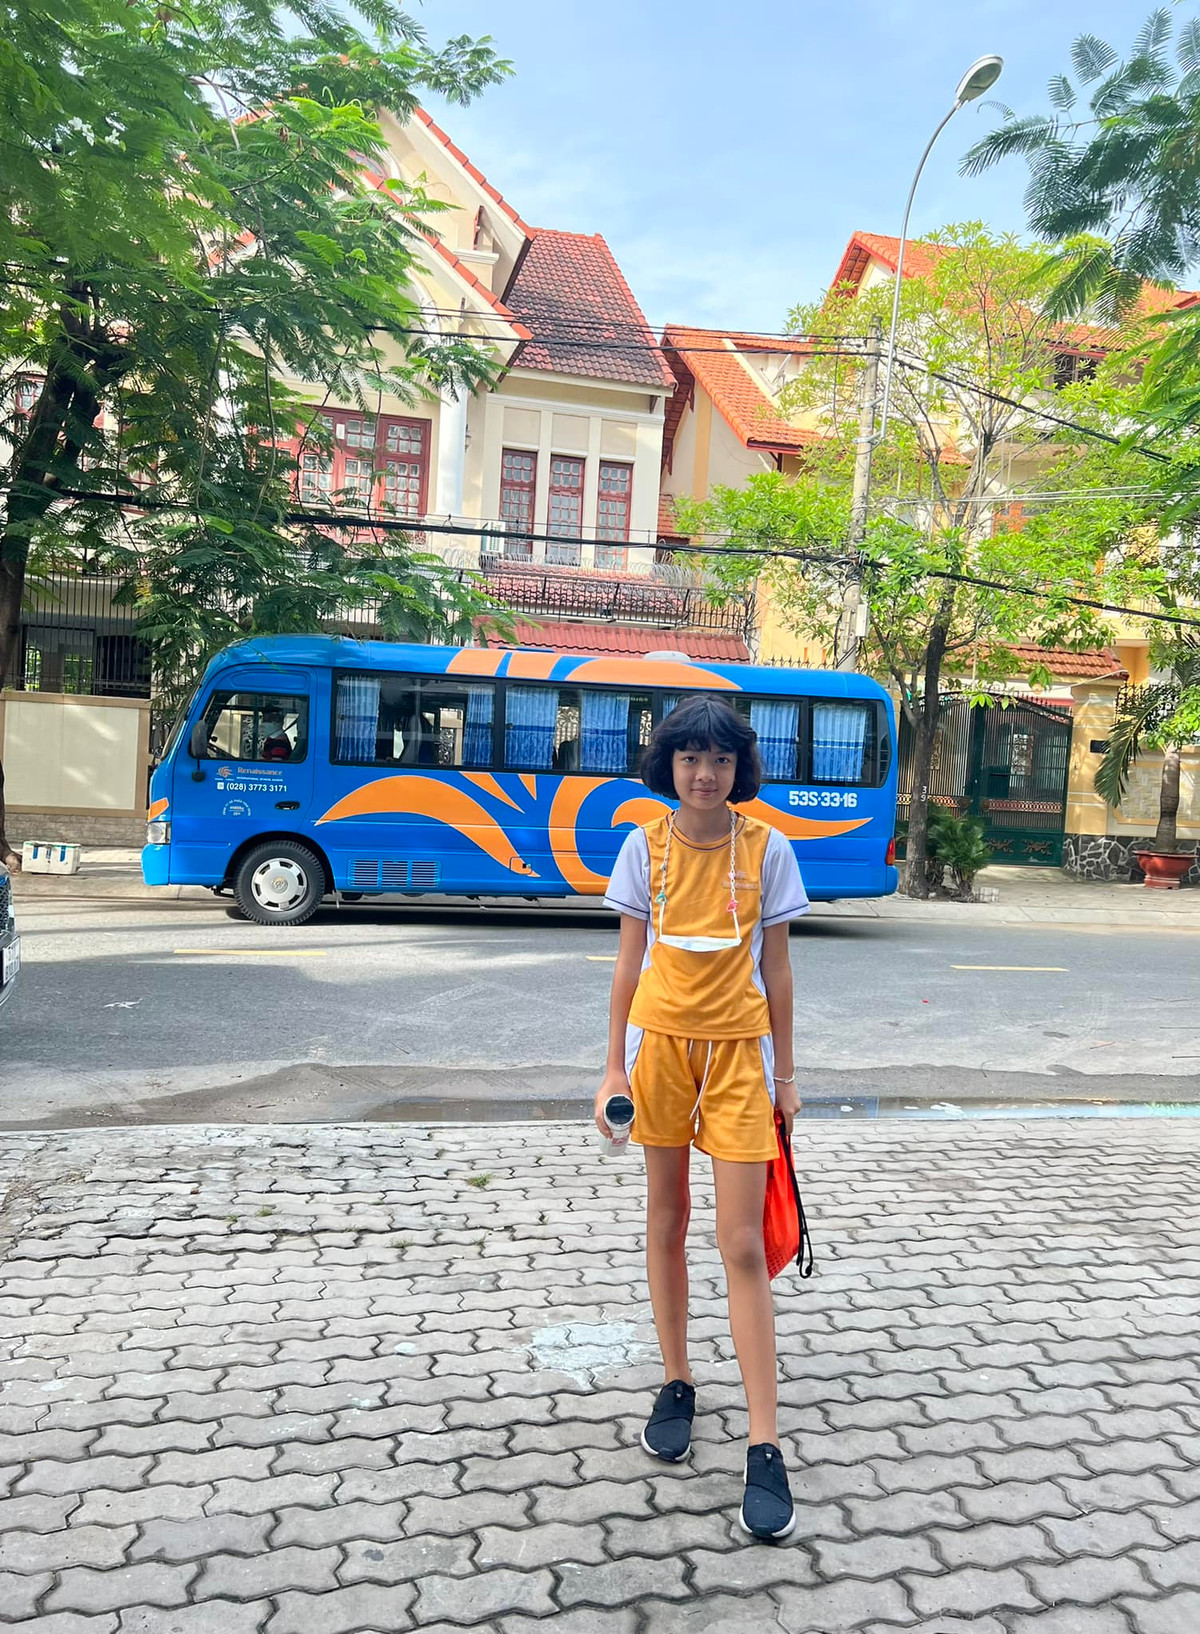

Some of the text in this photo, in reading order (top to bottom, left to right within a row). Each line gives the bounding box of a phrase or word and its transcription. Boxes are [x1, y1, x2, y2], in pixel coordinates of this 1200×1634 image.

[226, 782, 287, 792] (028) 3773 3171
